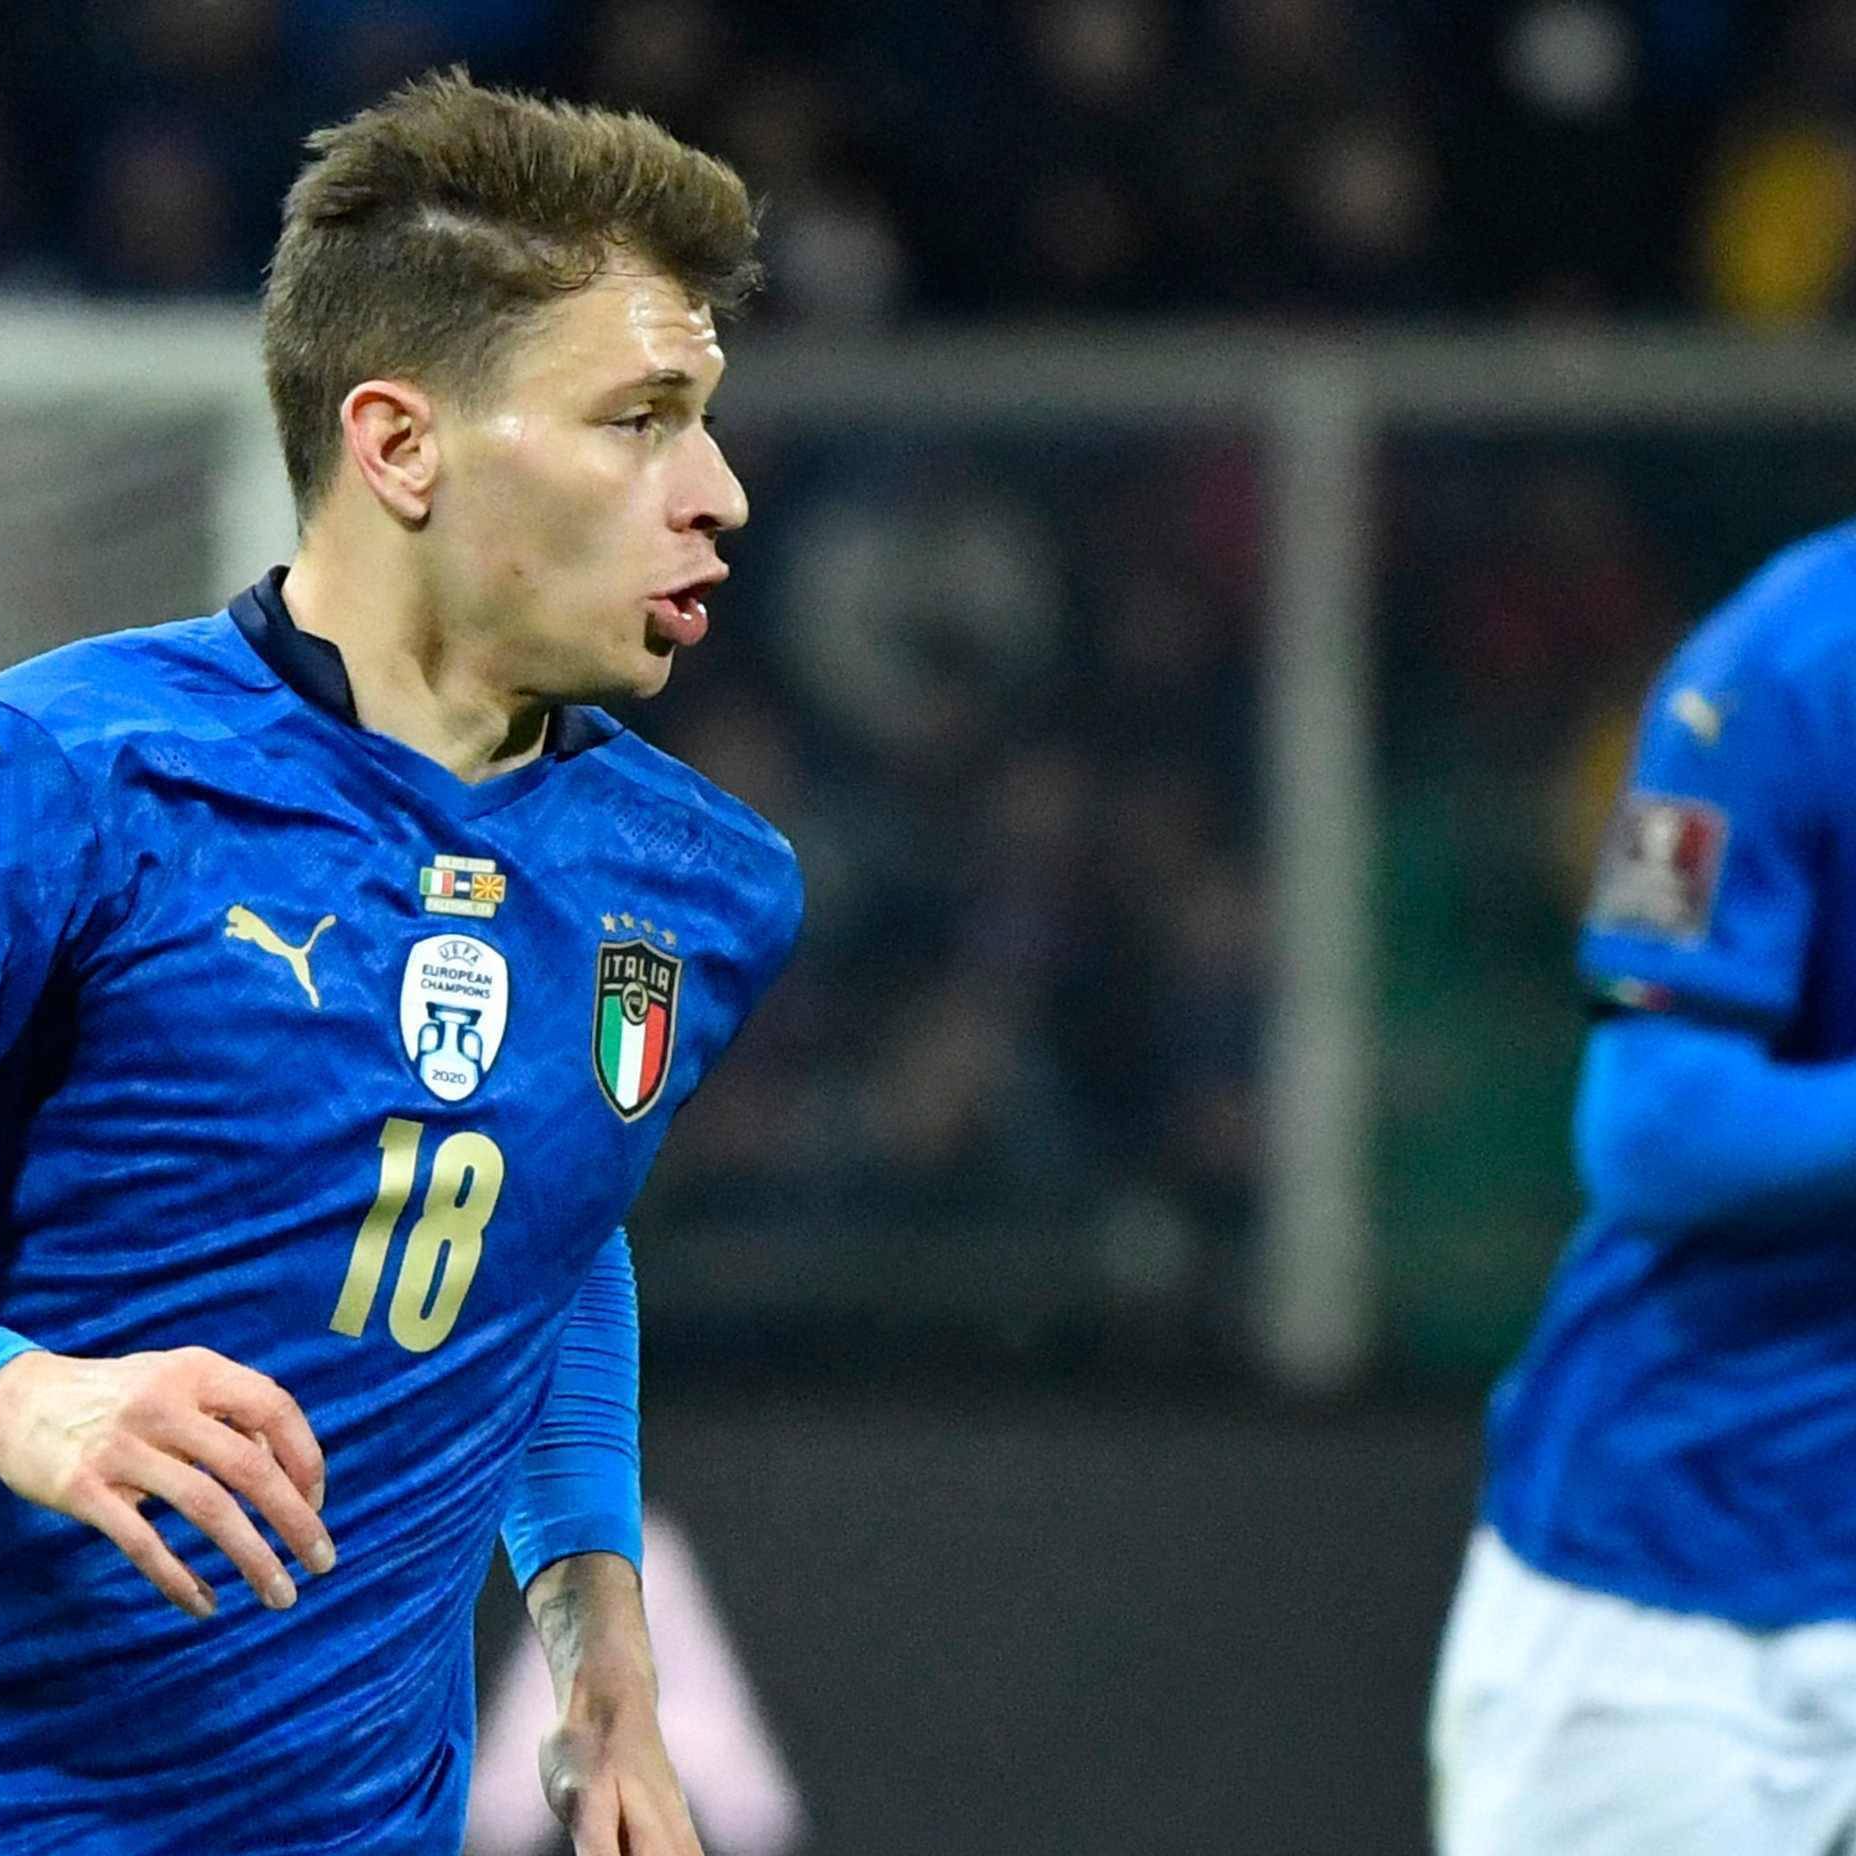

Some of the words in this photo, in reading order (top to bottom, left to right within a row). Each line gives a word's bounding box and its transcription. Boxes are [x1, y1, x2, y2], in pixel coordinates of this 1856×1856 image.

[439, 942, 479, 963] UEFA
[422, 964, 493, 985] EUROPEAN
[604, 954, 670, 992] ITALIA
[420, 978, 491, 999] CHAMPIONS
[431, 1069, 467, 1085] 2020
[329, 1117, 504, 1353] 18
